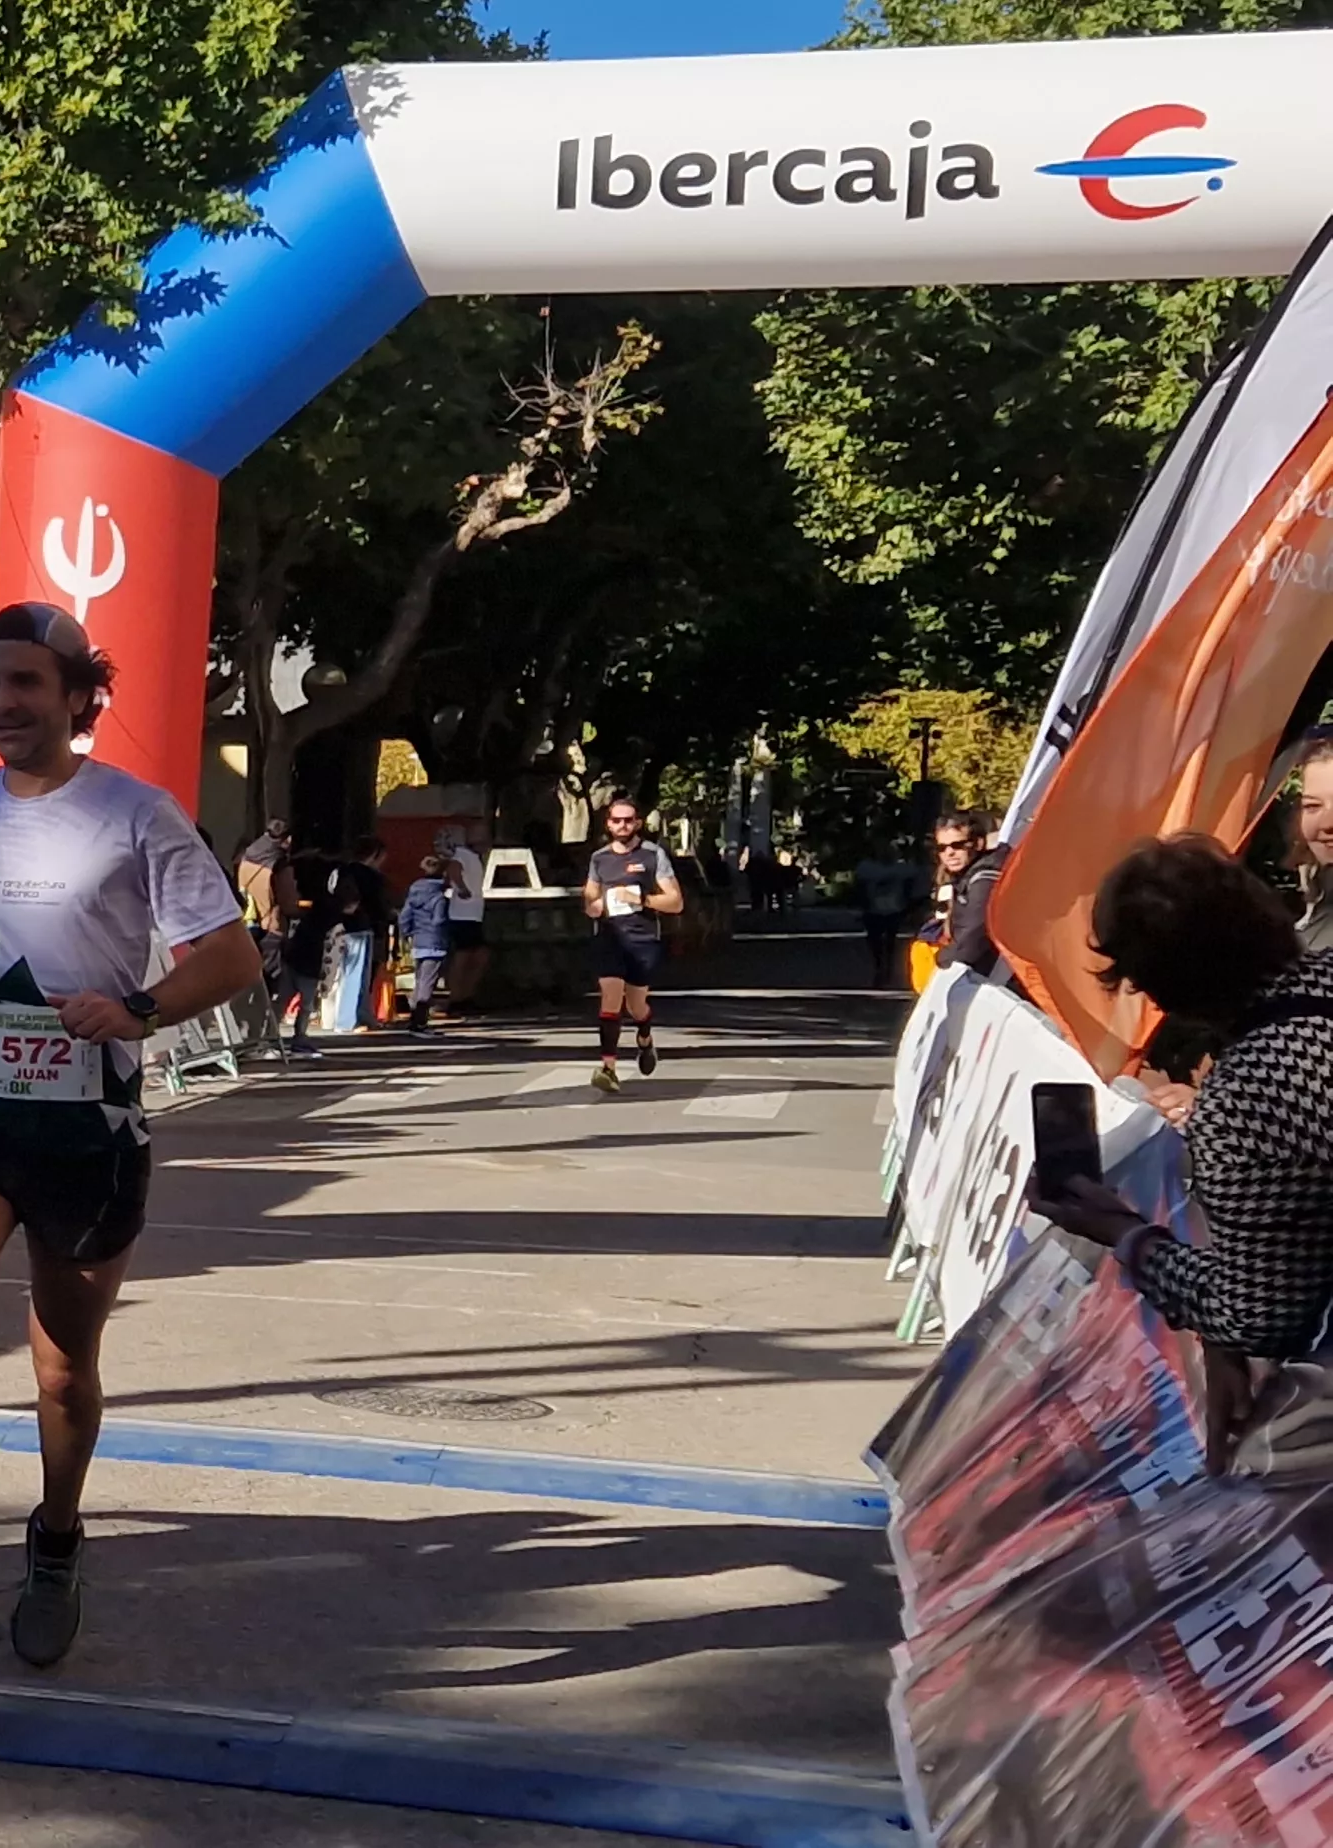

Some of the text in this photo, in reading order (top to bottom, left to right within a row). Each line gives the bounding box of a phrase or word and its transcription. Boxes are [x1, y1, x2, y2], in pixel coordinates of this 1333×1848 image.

[556, 119, 1000, 220] Ibercaja
[0, 1035, 73, 1066] 572
[12, 1067, 59, 1082] JUAN
